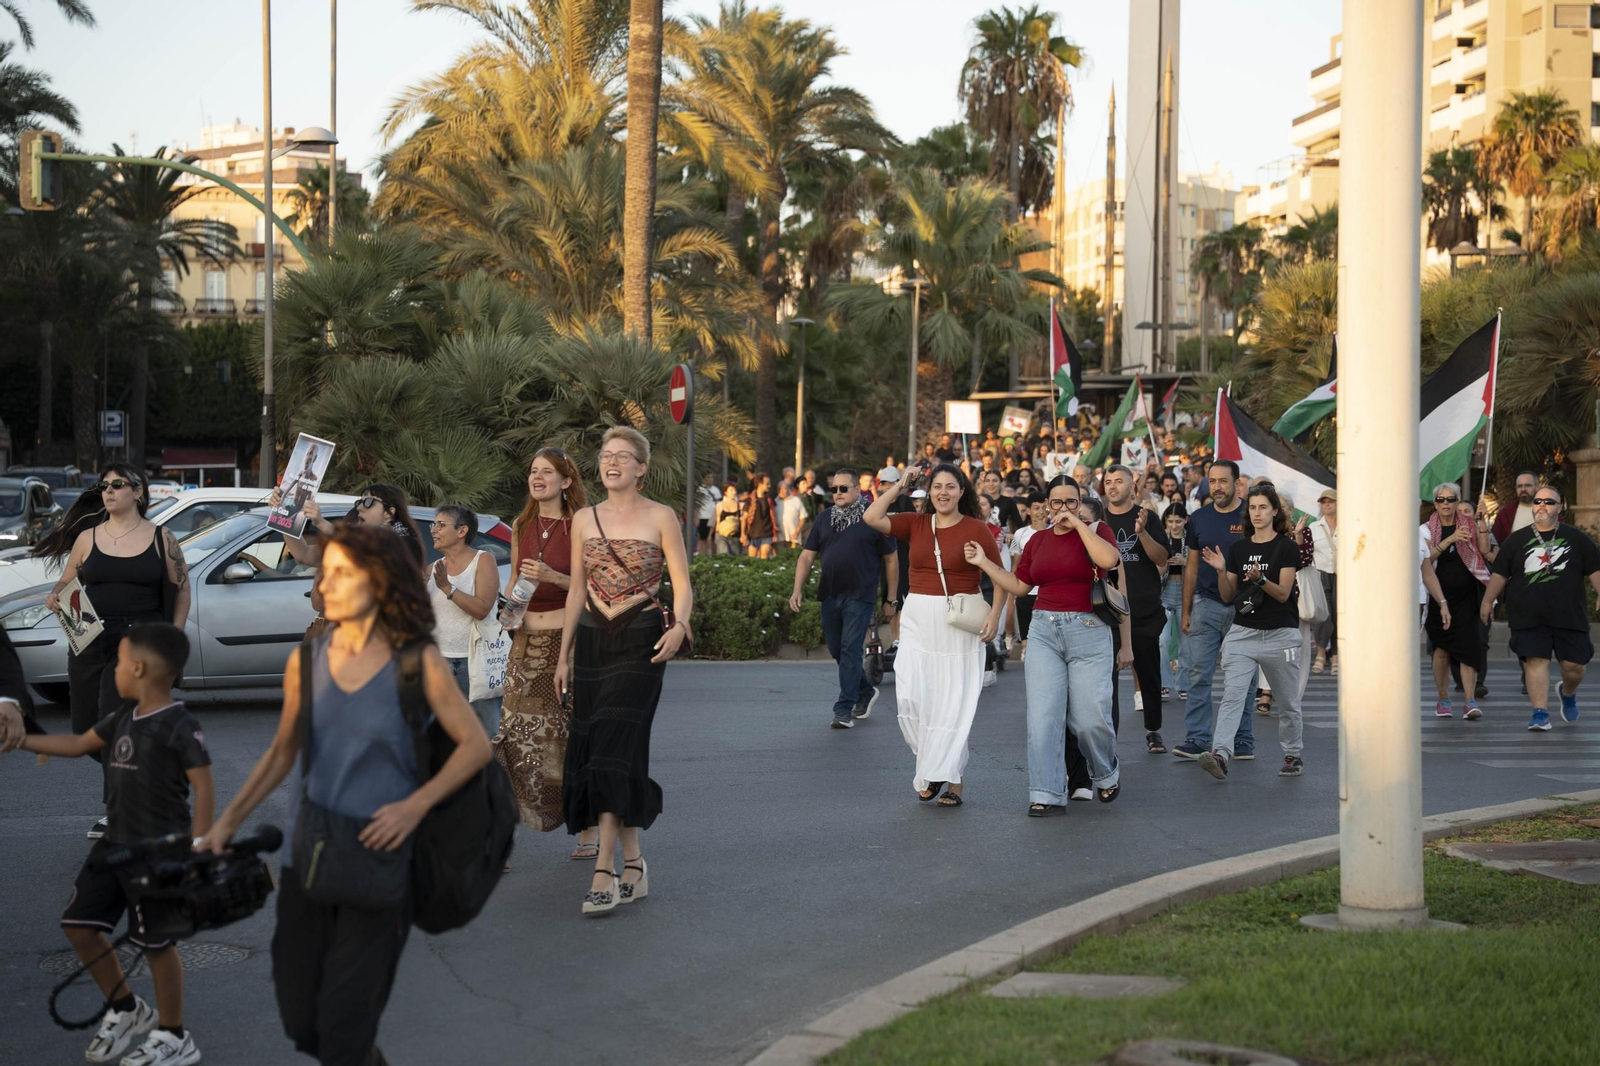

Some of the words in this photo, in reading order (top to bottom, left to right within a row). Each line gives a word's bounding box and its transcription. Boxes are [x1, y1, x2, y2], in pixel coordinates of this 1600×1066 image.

[106, 413, 121, 432] P
[277, 516, 293, 529] 2025
[1122, 551, 1139, 562] das
[485, 638, 505, 650] Todo
[486, 654, 507, 665] necesit
[489, 671, 506, 689] bol
